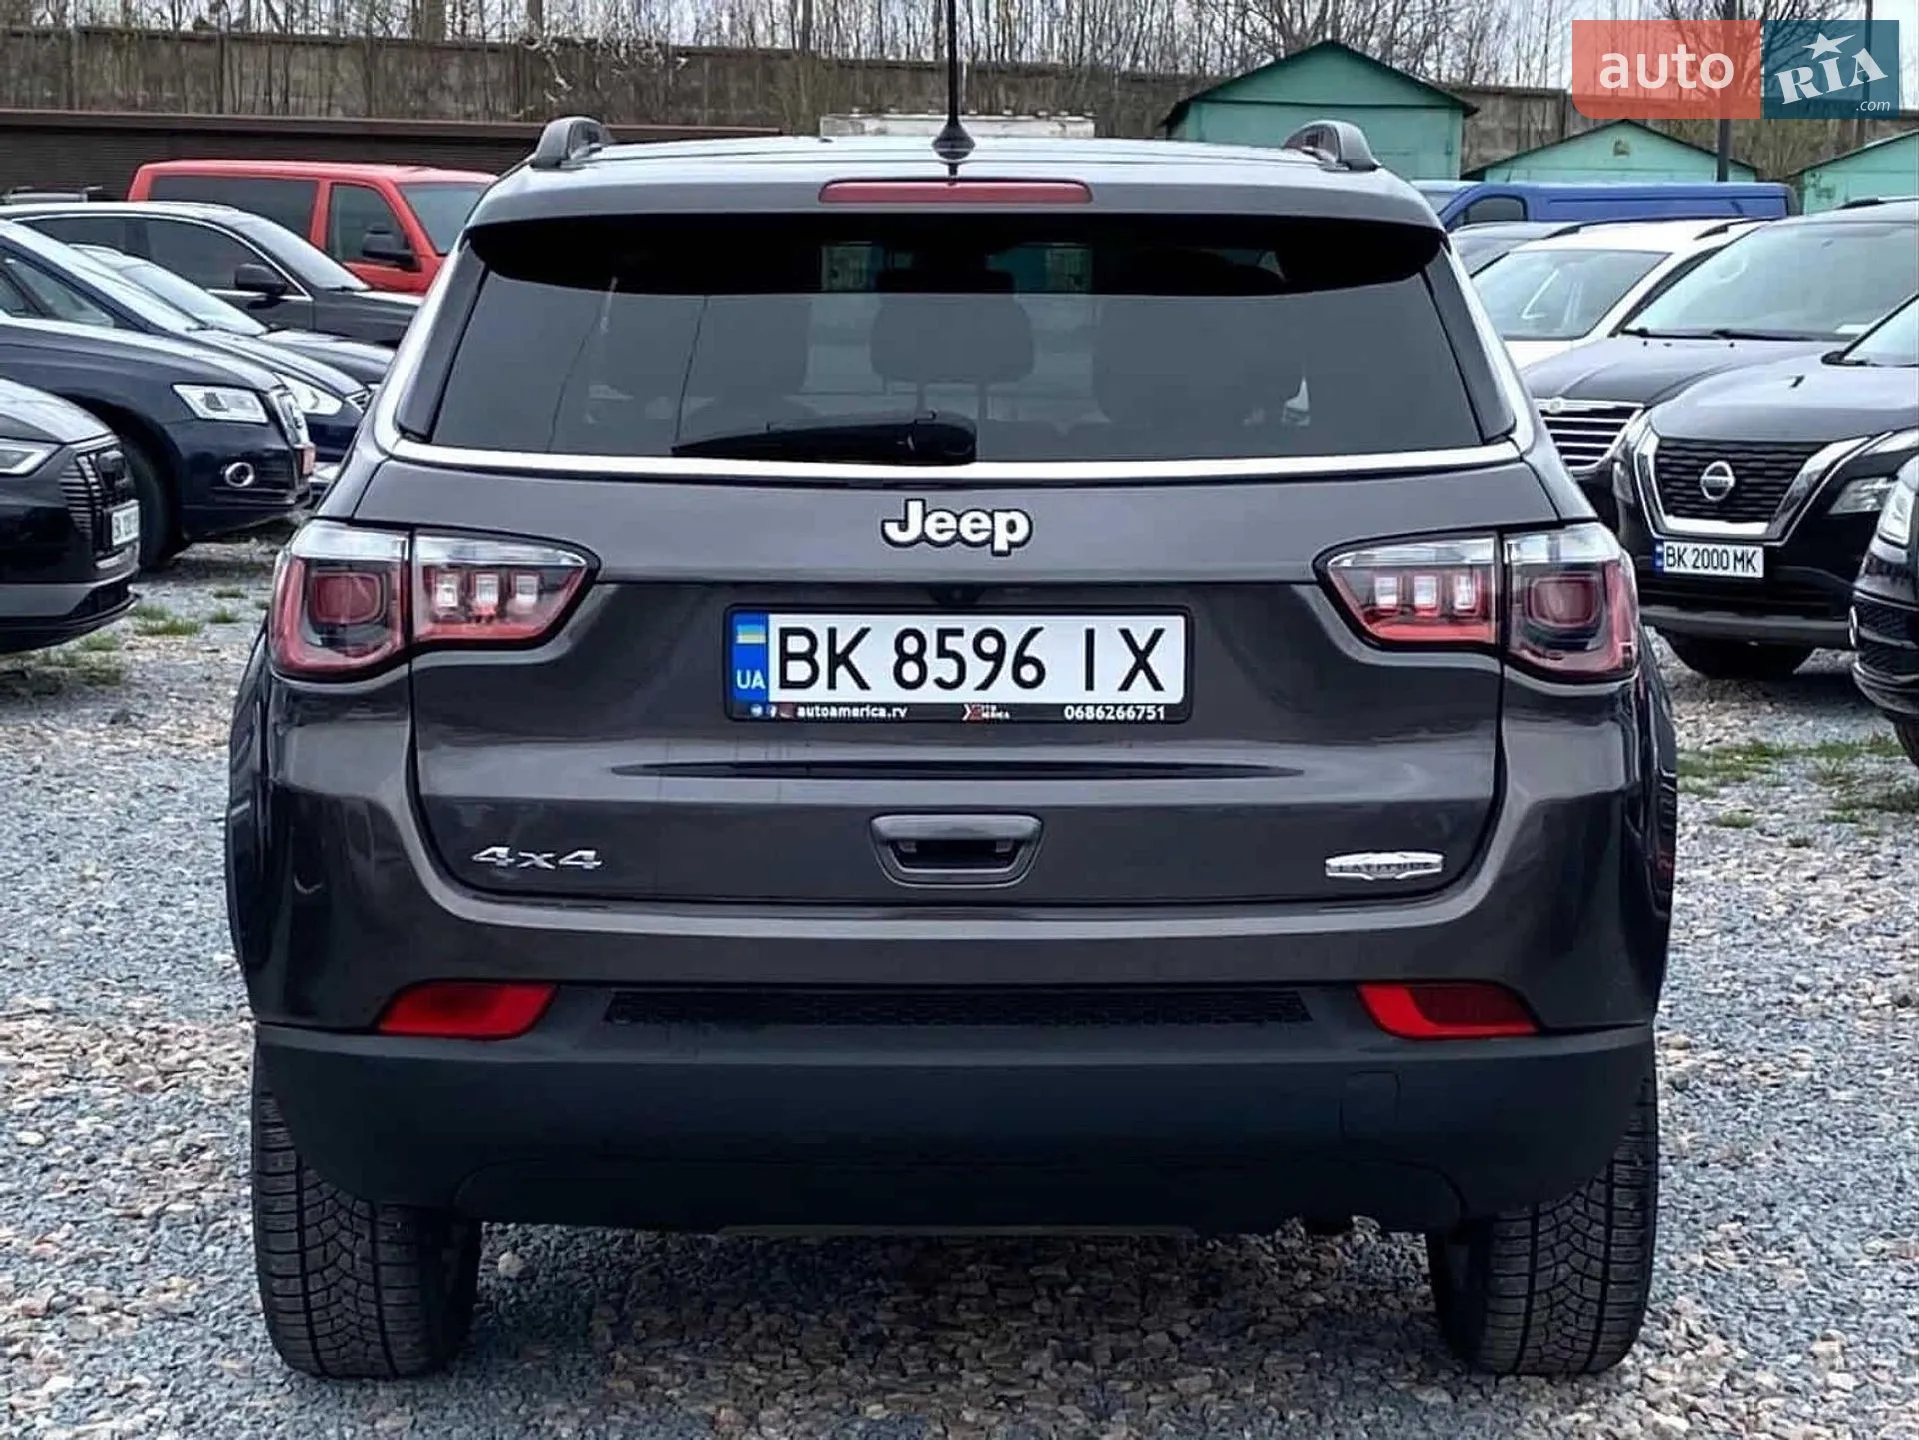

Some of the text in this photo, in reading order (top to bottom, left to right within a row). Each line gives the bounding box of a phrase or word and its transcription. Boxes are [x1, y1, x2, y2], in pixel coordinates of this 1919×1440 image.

[881, 498, 1033, 557] Jeep
[1665, 545, 1758, 573] BK 2000 MK
[778, 627, 871, 691] BK
[892, 626, 1046, 691] 8596
[736, 669, 766, 690] UA
[1063, 704, 1165, 721] 0686266751
[472, 846, 602, 870] 4x4
